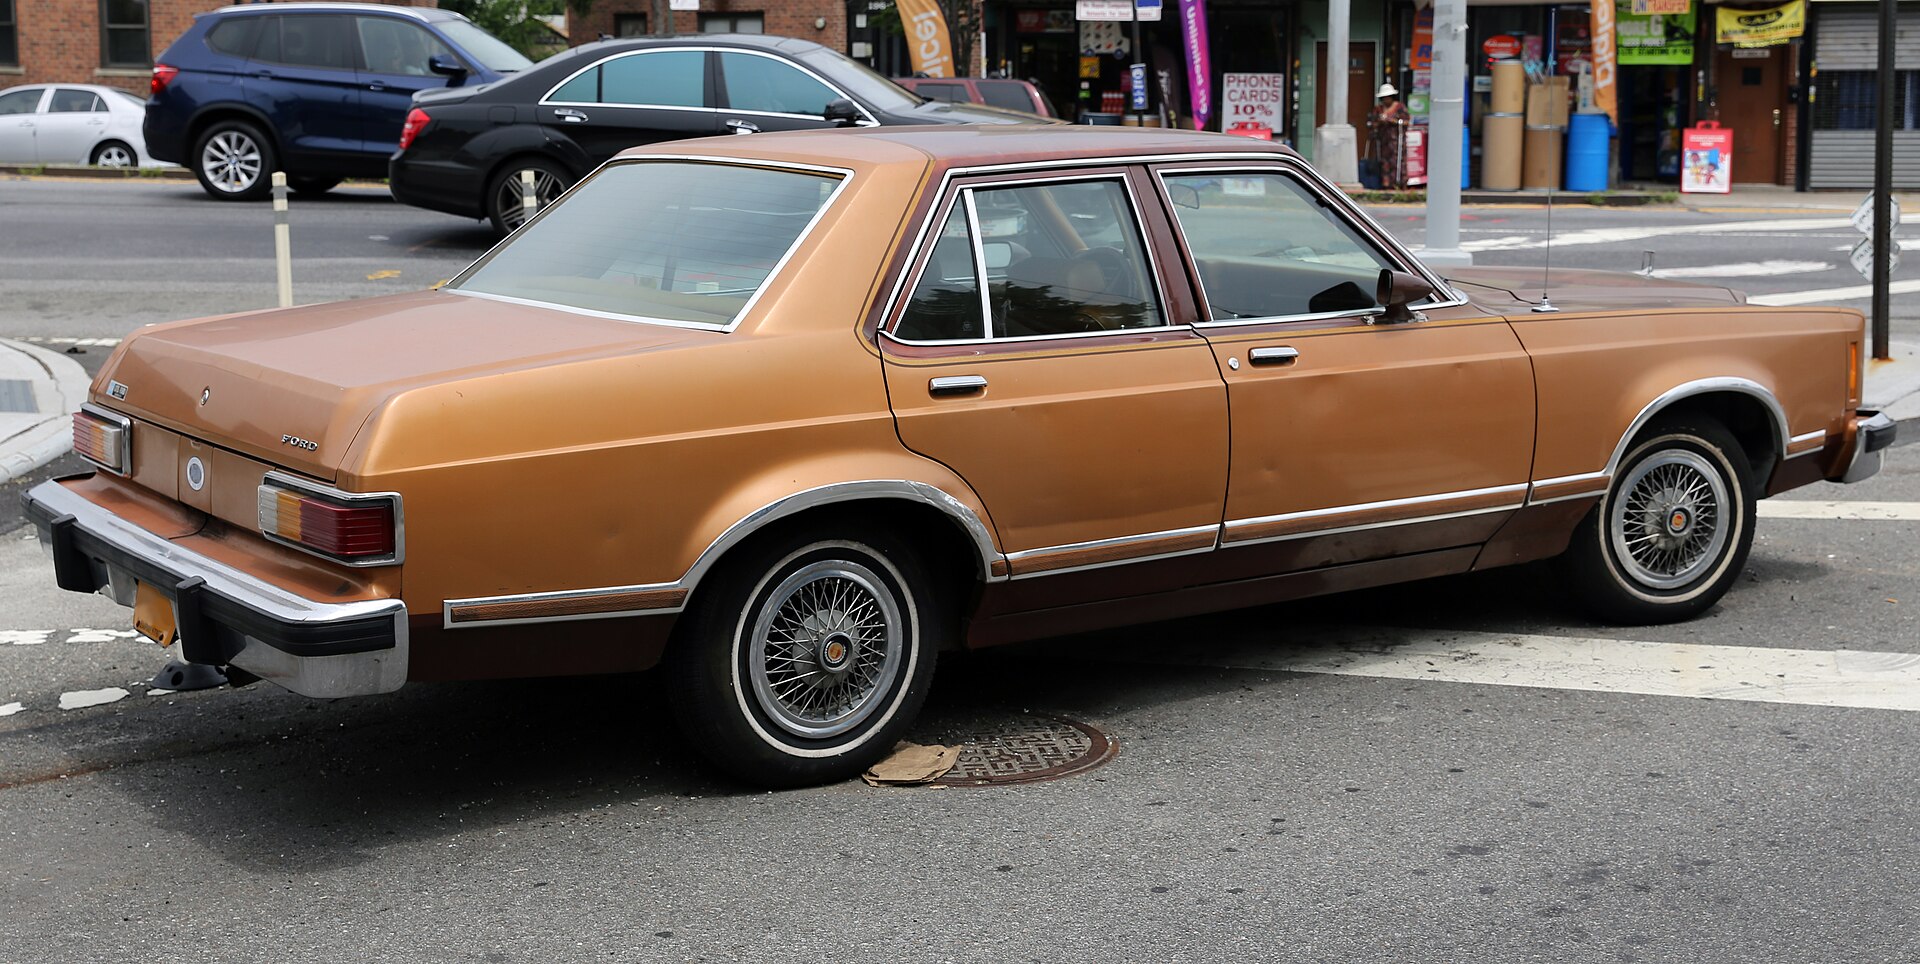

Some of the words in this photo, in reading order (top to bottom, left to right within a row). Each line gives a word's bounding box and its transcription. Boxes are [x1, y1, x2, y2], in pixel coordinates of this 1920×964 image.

[1186, 6, 1204, 86] Unlimited
[1226, 75, 1282, 88] PHONE
[1228, 89, 1280, 103] CARDS
[1233, 104, 1273, 116] 10%
[281, 434, 318, 451] FORD
